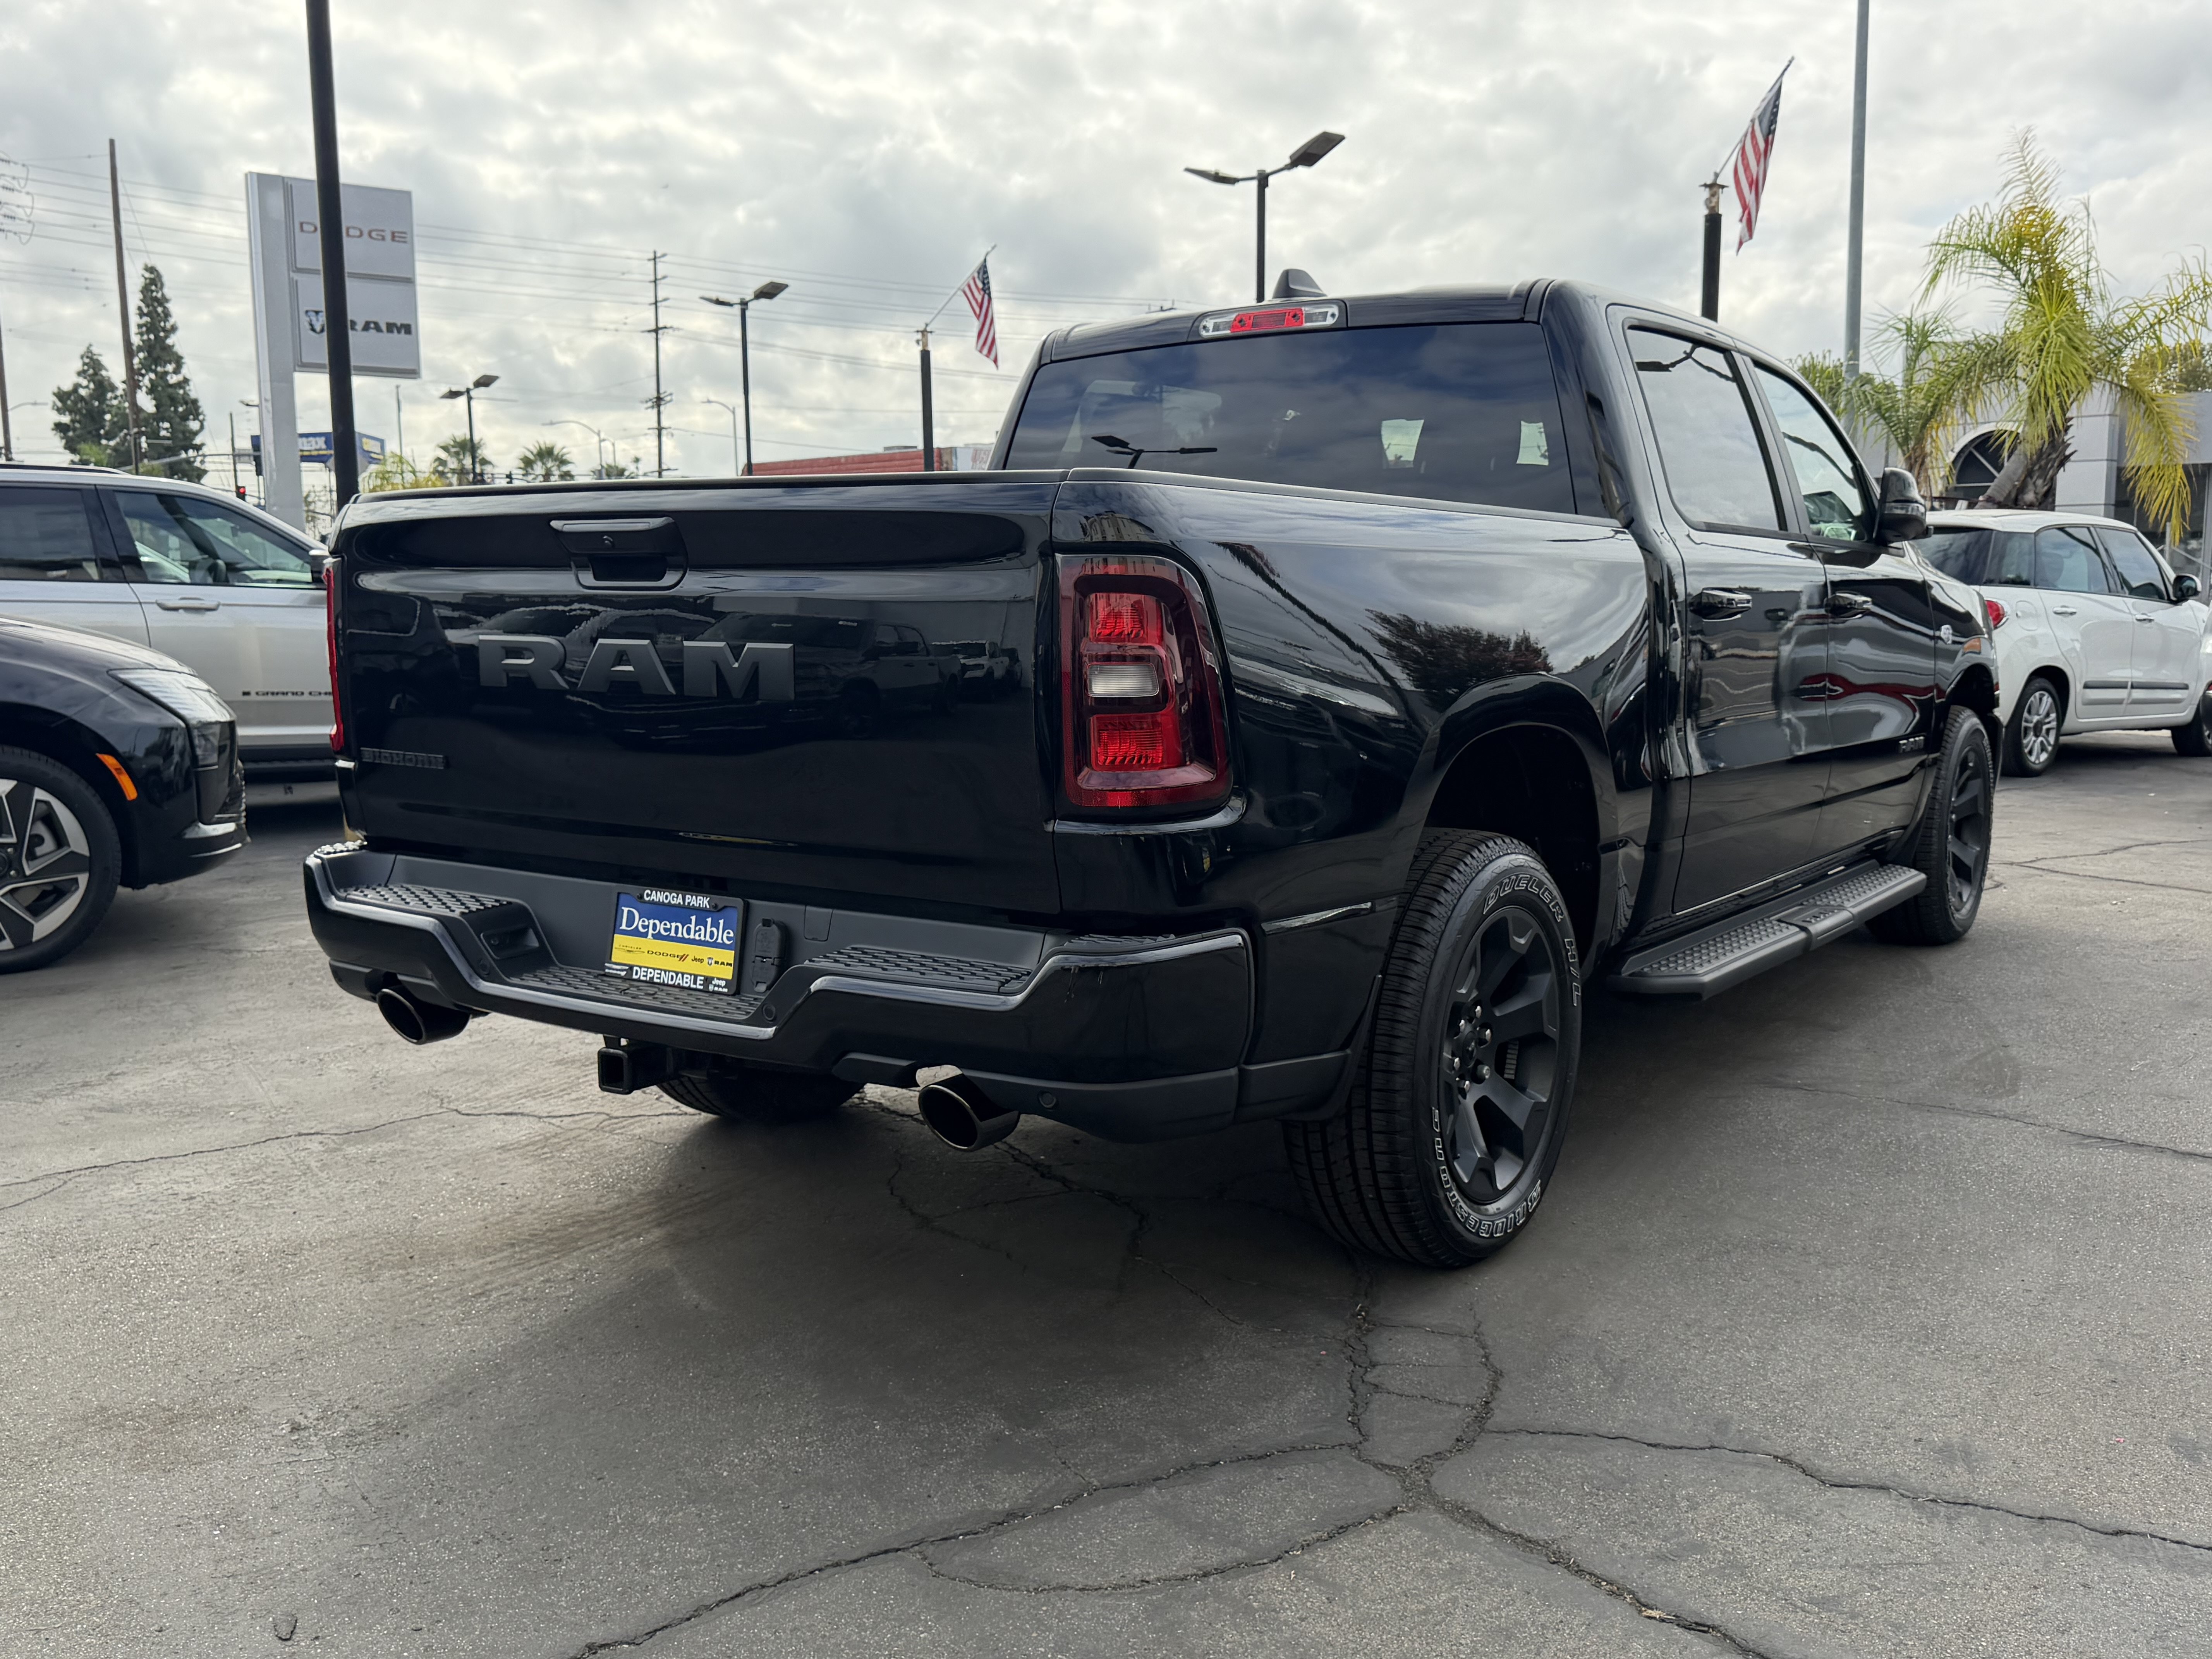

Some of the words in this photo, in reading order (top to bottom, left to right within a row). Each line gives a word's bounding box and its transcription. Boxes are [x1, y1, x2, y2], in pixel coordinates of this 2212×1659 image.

[299, 221, 409, 244] DDGE
[479, 635, 795, 700] RAM
[1899, 736, 1924, 754] RAM
[644, 890, 683, 905] CANOGA
[685, 895, 710, 908] PARK
[1483, 874, 1565, 922] DUELER
[620, 907, 734, 944] Dependable
[647, 950, 682, 959] DODGE
[691, 955, 704, 964] Jeep
[632, 966, 704, 989] DEPENDABLE
[712, 977, 726, 987] Jeep
[1432, 1106, 1541, 1238] BRIDGESTONE
